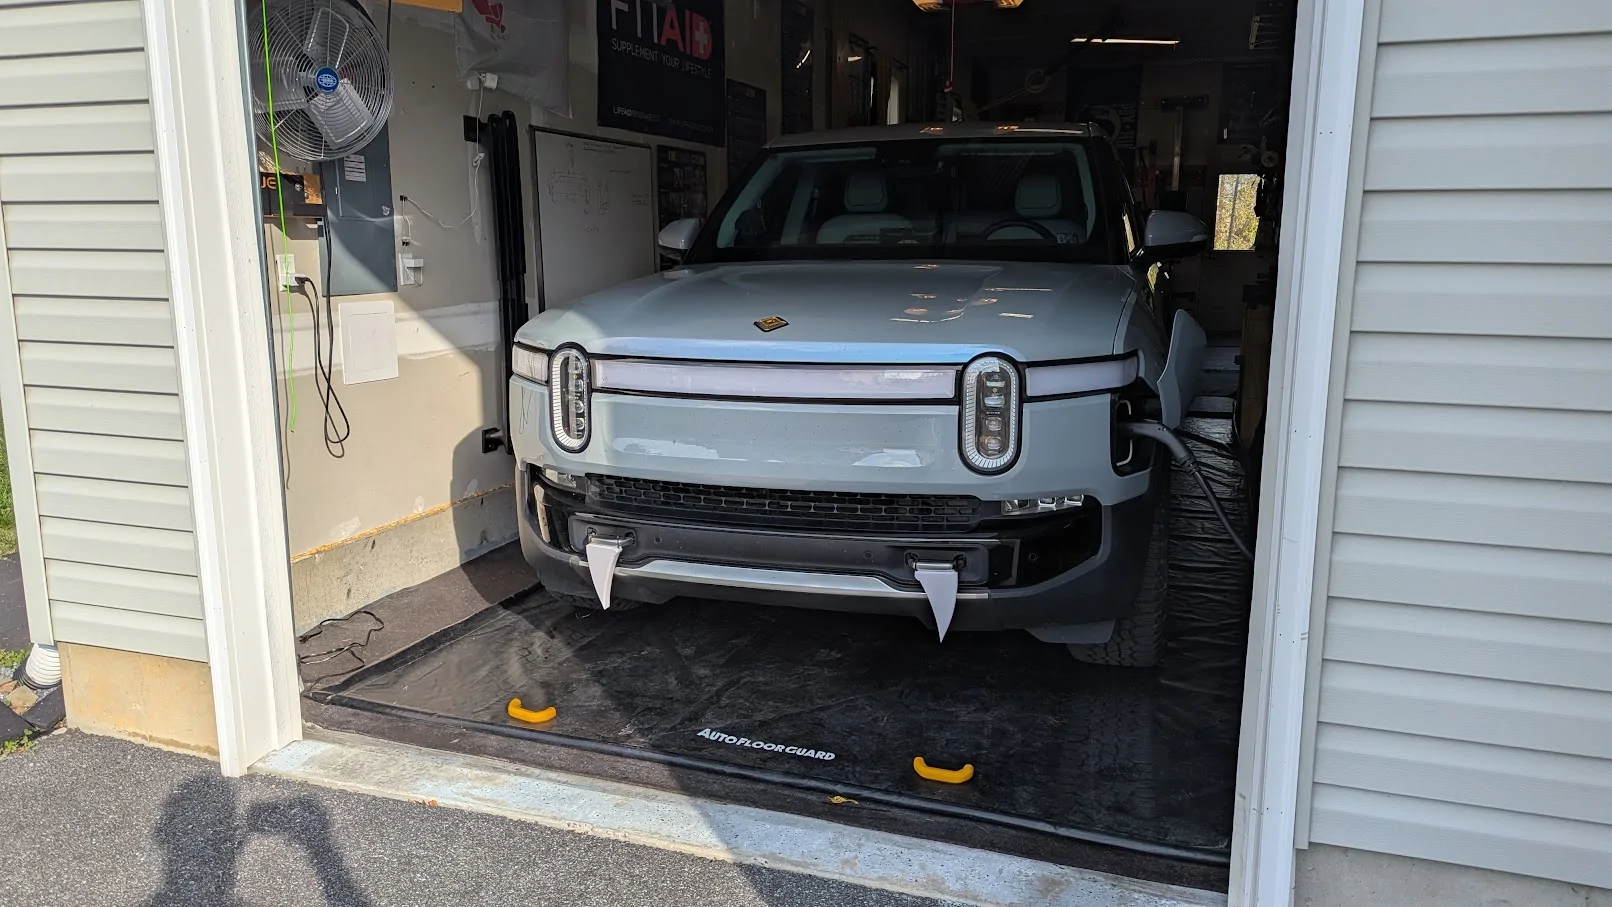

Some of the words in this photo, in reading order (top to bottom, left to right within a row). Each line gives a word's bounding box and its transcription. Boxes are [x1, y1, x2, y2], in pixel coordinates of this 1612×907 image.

[611, 38, 659, 62] SUPPLEMENT
[661, 53, 680, 69] YOUR
[682, 60, 713, 79] LIFESTYLE
